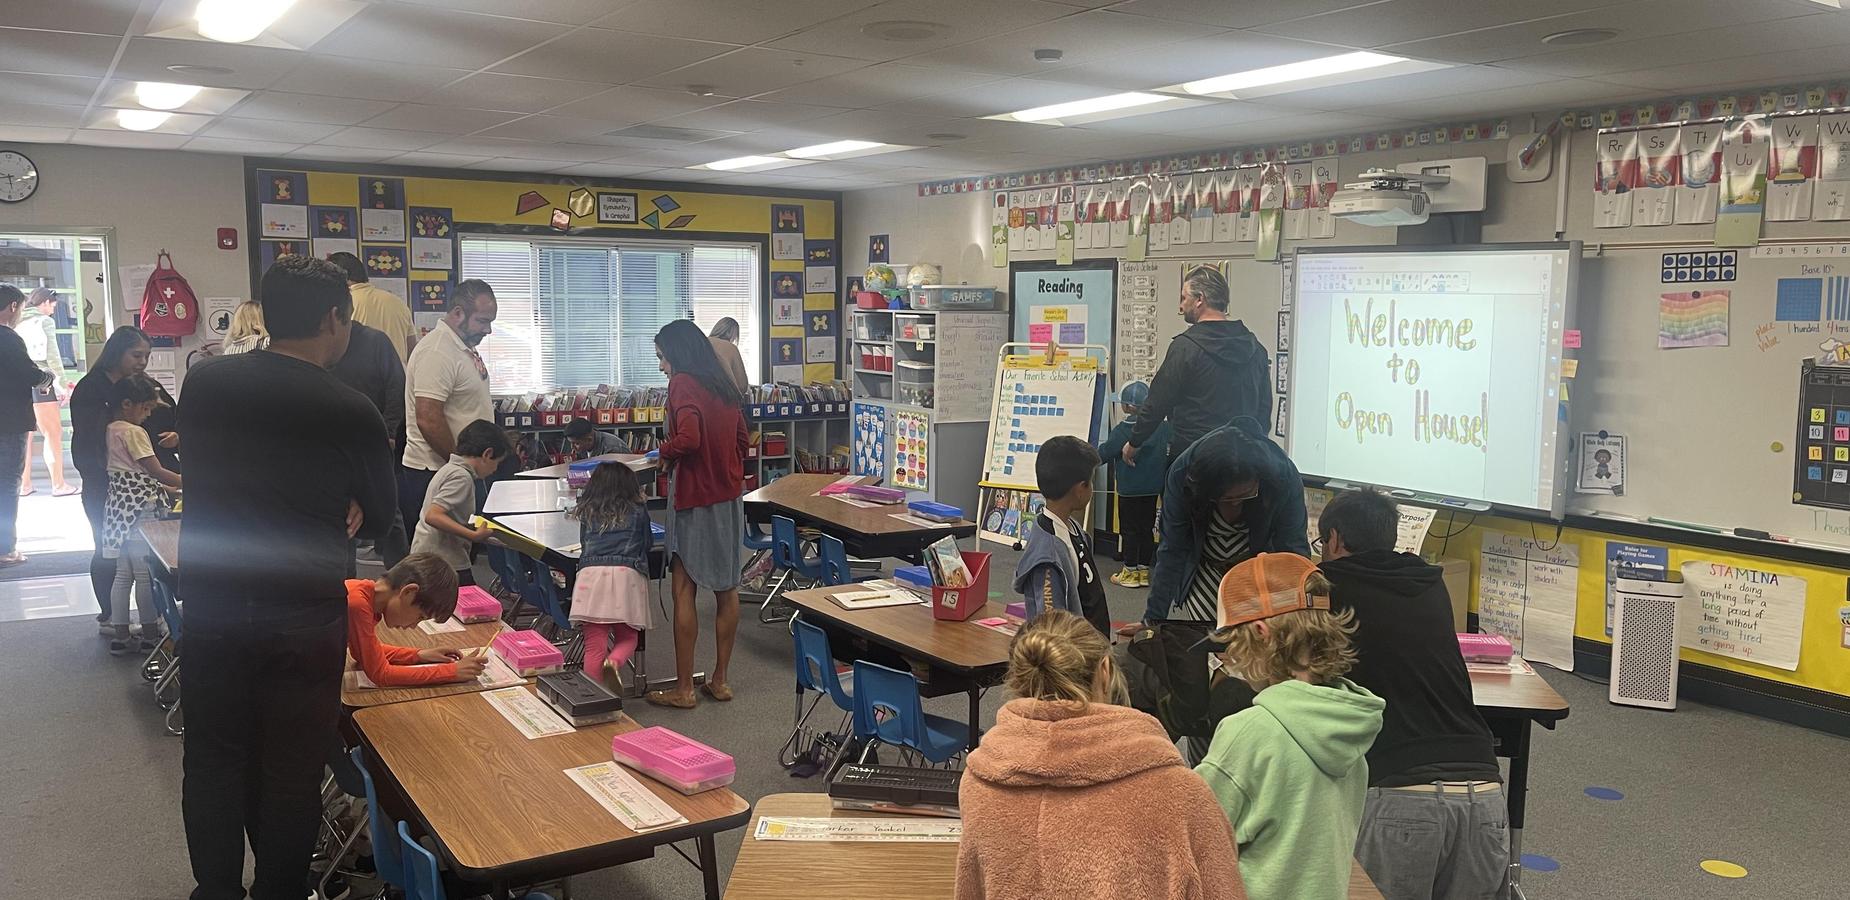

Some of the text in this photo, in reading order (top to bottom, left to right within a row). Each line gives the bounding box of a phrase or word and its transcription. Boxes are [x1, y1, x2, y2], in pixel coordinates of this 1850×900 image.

[1694, 131, 1708, 144] Tt
[1785, 124, 1801, 138] Vv
[1608, 139, 1623, 152] Rr
[1650, 136, 1665, 148] Ss
[1735, 153, 1753, 166] Uu
[1317, 167, 1330, 180] Qq
[1038, 278, 1084, 300] Reading
[1343, 297, 1477, 350] Welcome
[1387, 353, 1420, 385] to
[1335, 389, 1489, 453] Open House!
[1813, 410, 1821, 420] 3
[1811, 428, 1821, 437] 10
[1837, 430, 1845, 439] 11
[1811, 449, 1819, 458] 17
[1834, 471, 1843, 479] 25
[1400, 511, 1432, 523] urpose?
[1617, 550, 1637, 559] Playing
[1709, 563, 1779, 586] STAMINA
[1740, 583, 1762, 597] doing
[944, 592, 957, 605] 15
[1700, 590, 1737, 606] anything
[1744, 595, 1755, 605] for
[1702, 600, 1764, 620] long period of
[1704, 612, 1758, 631] time without
[1697, 624, 1762, 644] getting tired
[1700, 637, 1709, 645] or
[1742, 647, 1753, 656] up
